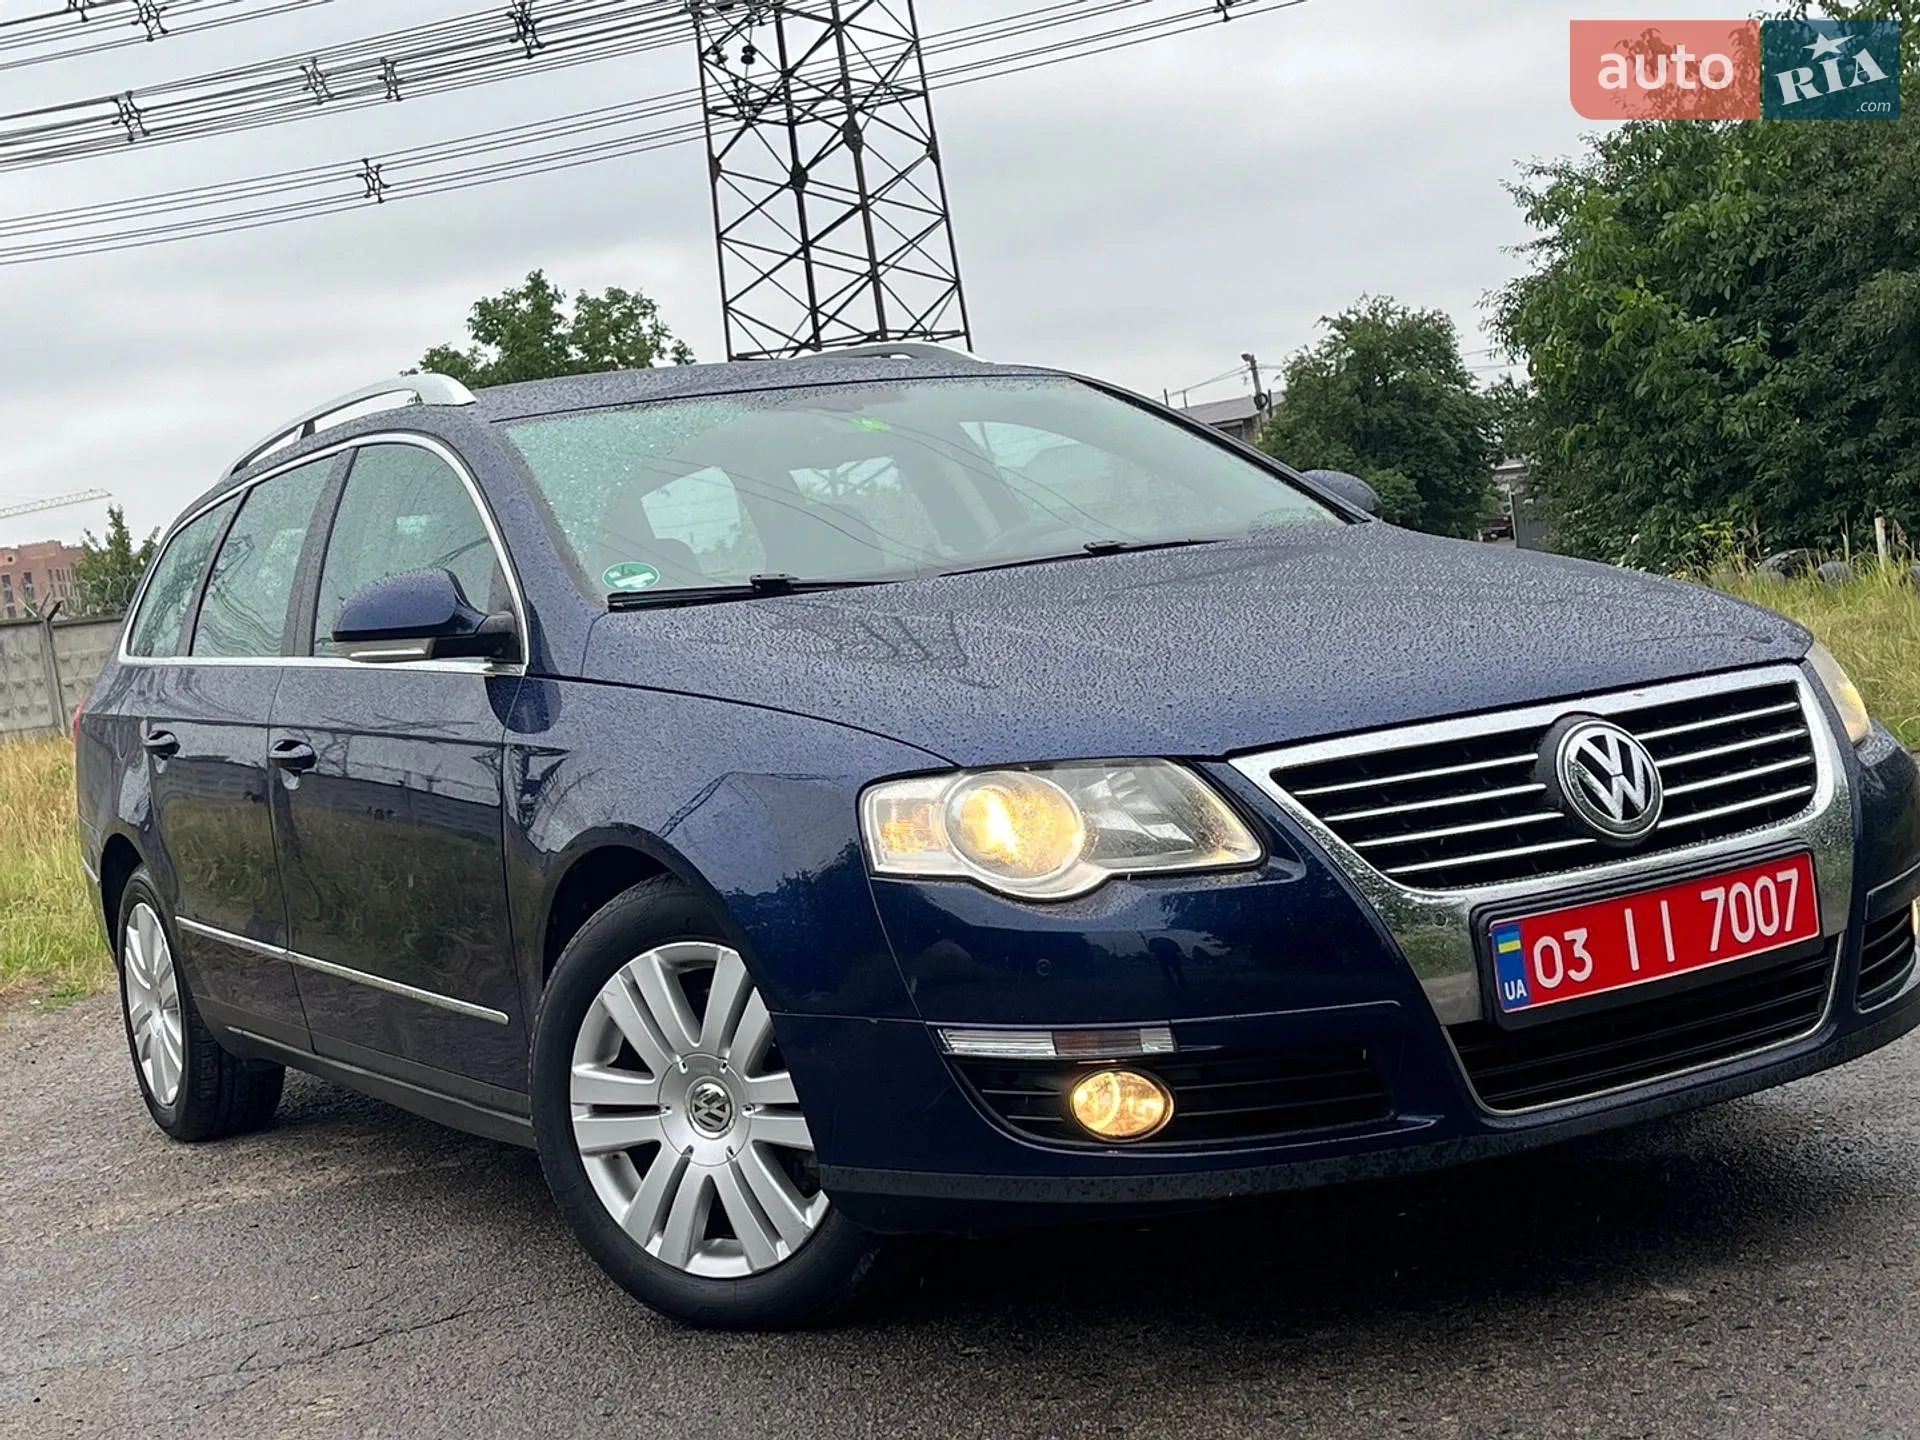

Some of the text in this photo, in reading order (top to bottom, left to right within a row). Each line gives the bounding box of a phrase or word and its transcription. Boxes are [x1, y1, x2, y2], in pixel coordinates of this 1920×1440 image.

[1534, 927, 1593, 989] 03
[1700, 867, 1799, 952] 7007
[1504, 978, 1527, 1000] UA
